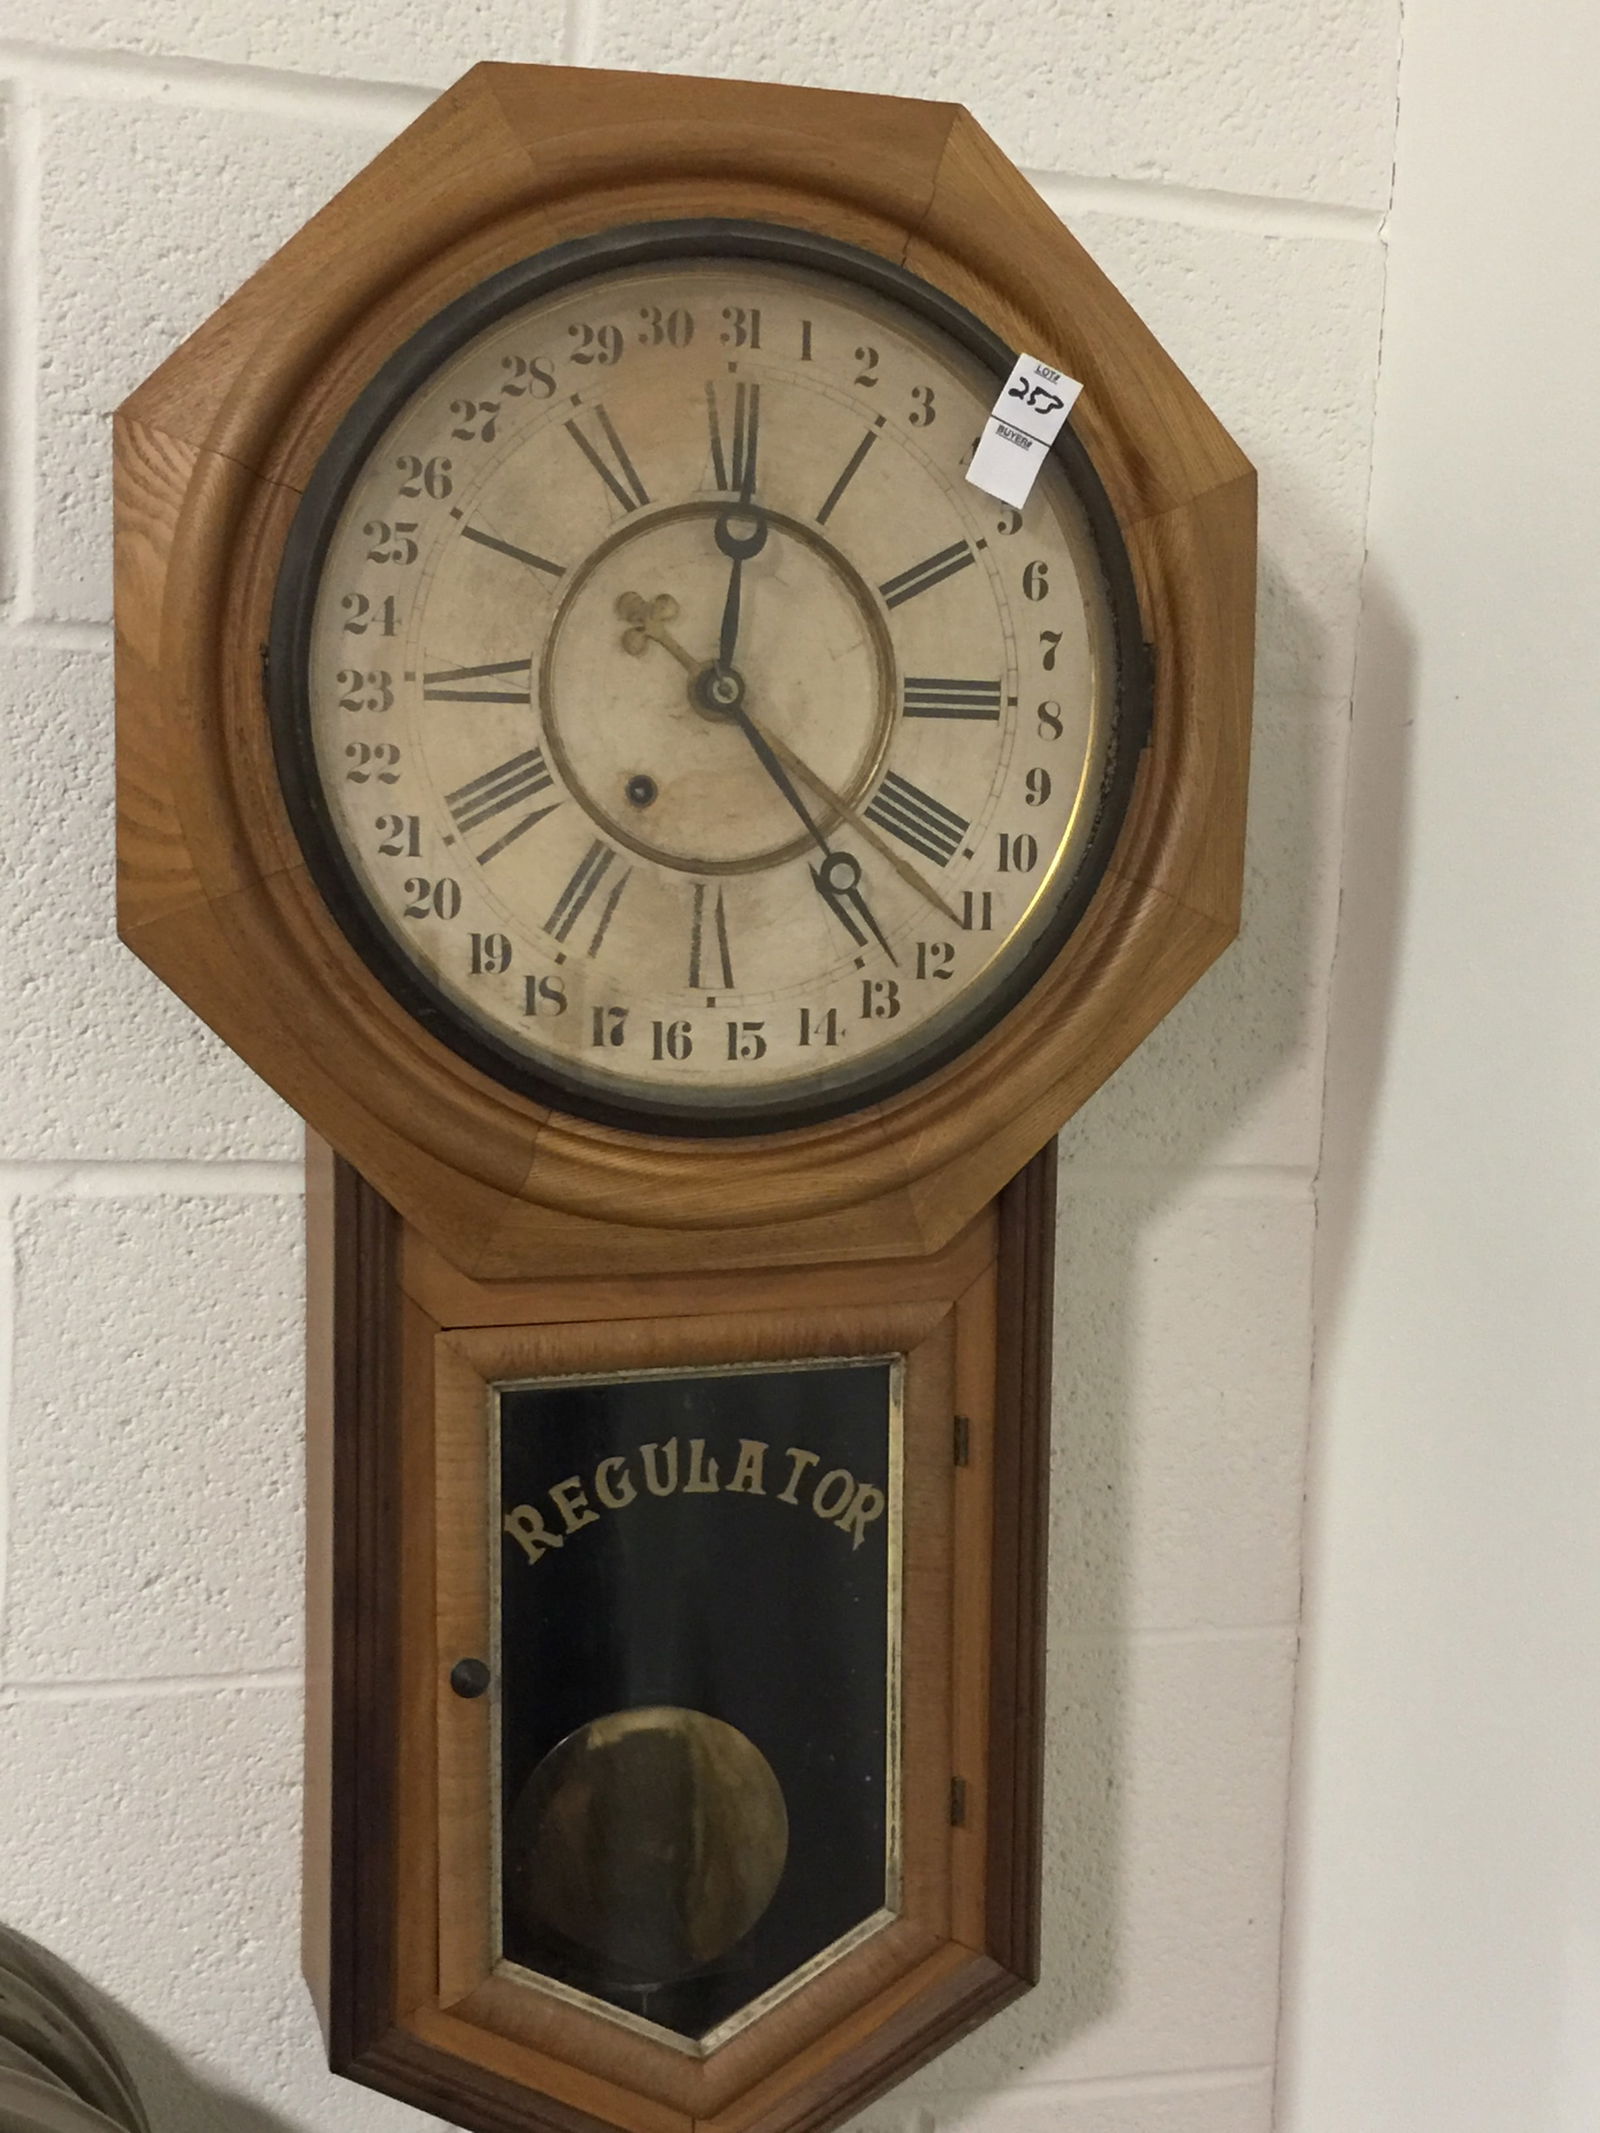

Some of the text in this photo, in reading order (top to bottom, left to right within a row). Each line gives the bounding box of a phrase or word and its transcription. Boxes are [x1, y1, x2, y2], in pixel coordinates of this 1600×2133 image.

[568, 323, 625, 366] 29
[637, 306, 694, 349] 30
[720, 306, 762, 350] 31
[801, 320, 813, 361] 1
[500, 355, 557, 399] 28
[854, 346, 879, 388] 2
[1034, 364, 1061, 384] LOT#
[449, 399, 501, 444] 27
[908, 386, 936, 427] 3
[996, 424, 1033, 451] BUYER#
[395, 455, 454, 500] 26
[362, 520, 419, 566] 25
[1022, 560, 1049, 602] 6
[341, 593, 403, 637] 24
[1039, 630, 1063, 671] 7
[336, 669, 395, 713] 23
[1037, 700, 1064, 741] 8
[344, 742, 401, 785] 22
[1025, 767, 1052, 807] 9
[374, 814, 423, 858] 21
[996, 833, 1038, 873] 10
[403, 876, 463, 920] 20
[961, 891, 992, 931] 11
[467, 932, 513, 975] 19
[915, 942, 956, 980] 12
[522, 975, 568, 1017] 18
[858, 979, 900, 1019] 13
[592, 1006, 631, 1048] 17
[651, 1020, 693, 1061] 16
[726, 1021, 767, 1061] 15
[798, 1007, 846, 1046] 14
[504, 1436, 885, 1566] REGULATOR
